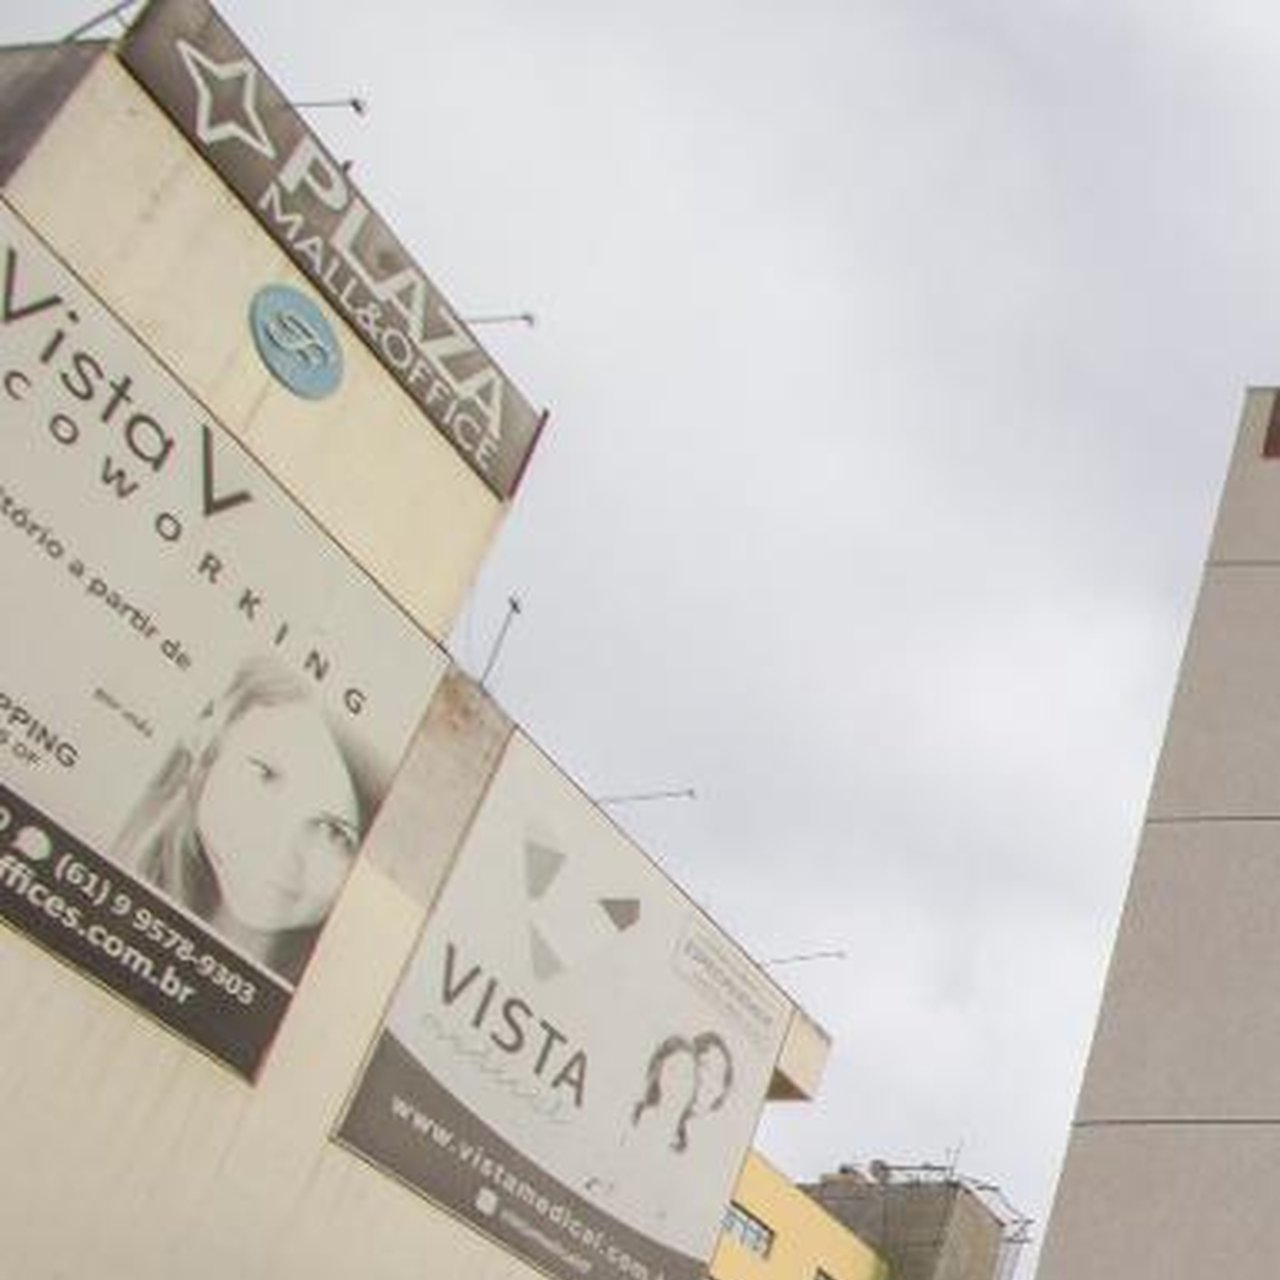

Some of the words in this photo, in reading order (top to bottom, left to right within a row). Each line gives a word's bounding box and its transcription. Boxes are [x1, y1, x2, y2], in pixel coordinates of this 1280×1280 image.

[278, 135, 505, 441] PLAZA
[87, 578, 158, 638] partir
[160, 638, 192, 671] de
[54, 852, 111, 906] (61)
[110, 893, 132, 916] 9
[443, 942, 588, 1109] VISTA
